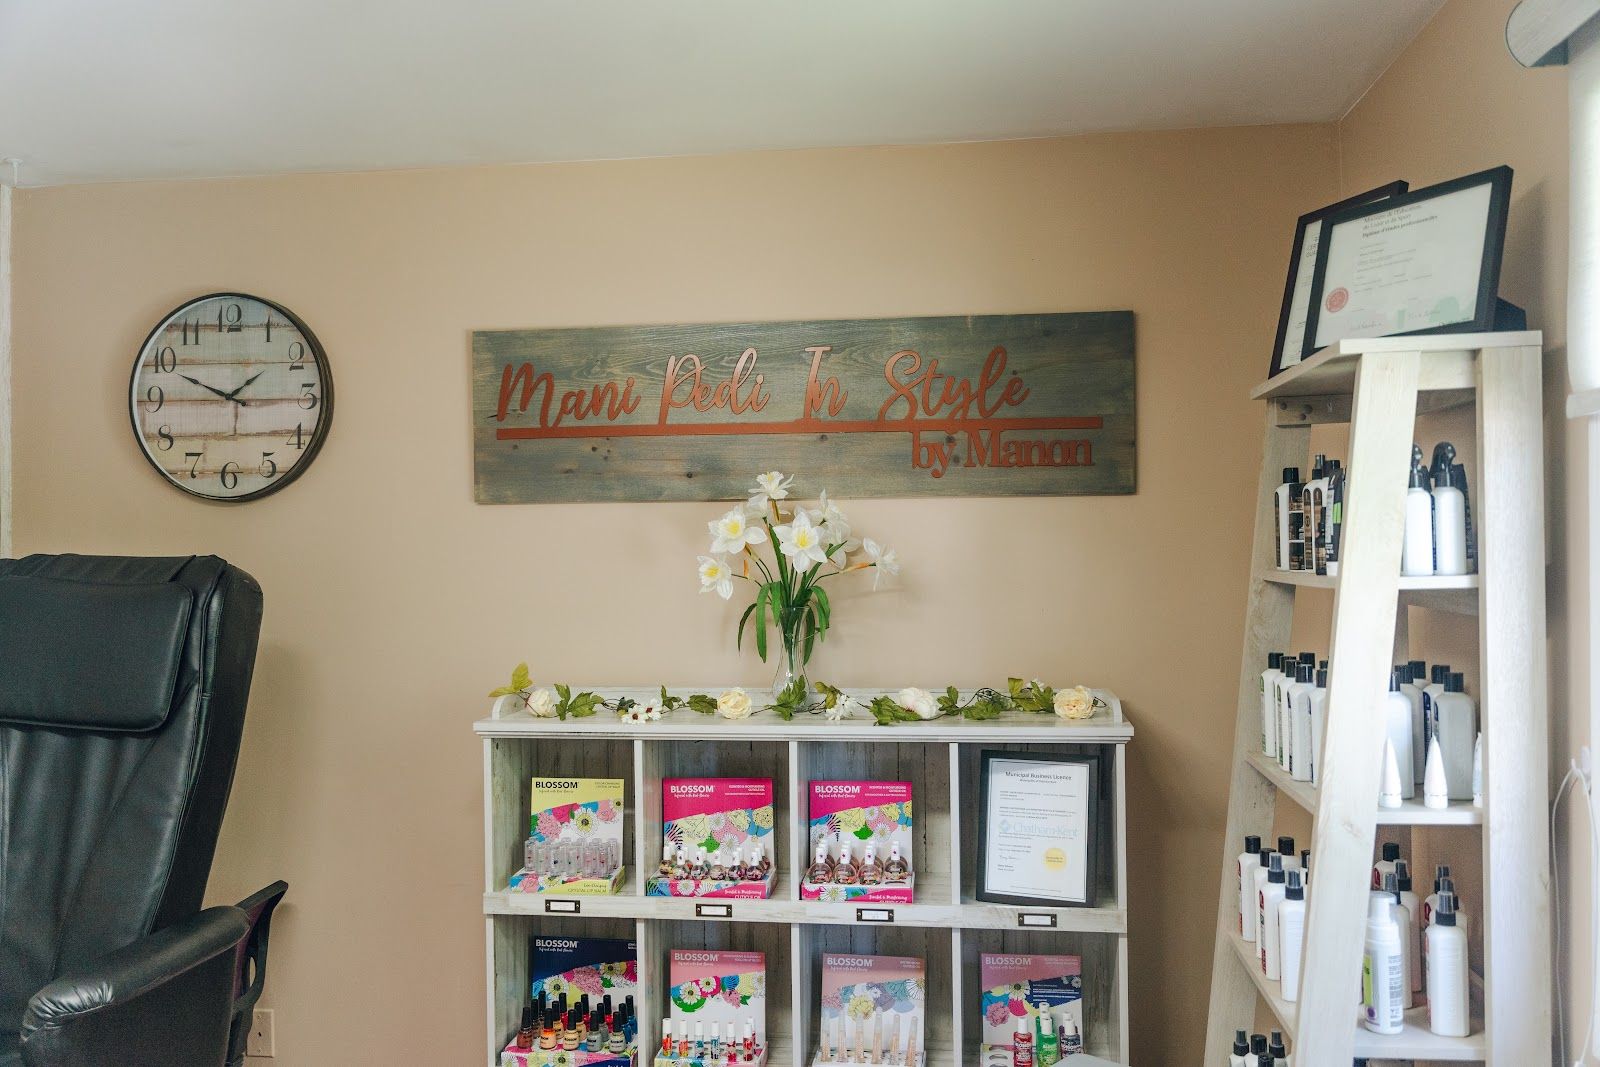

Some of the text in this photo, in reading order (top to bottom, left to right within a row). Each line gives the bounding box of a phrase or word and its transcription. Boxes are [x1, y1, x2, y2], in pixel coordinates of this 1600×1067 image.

[181, 317, 201, 346] 11
[216, 303, 242, 334] 12
[263, 314, 272, 343] 1
[153, 346, 177, 374] 10
[288, 341, 305, 372] 2
[144, 385, 164, 413] 9
[297, 382, 318, 410] 3
[496, 344, 1031, 434] Mani Pedi In Style
[157, 424, 174, 451] 8
[286, 421, 306, 450] 4
[184, 452, 204, 479] 7
[258, 451, 277, 479] 5
[911, 429, 1096, 479] by Manon
[220, 461, 240, 490] 6
[535, 781, 578, 789] BLOSSOM
[670, 785, 714, 793] BLOSSOM
[815, 785, 860, 794] BLOSSOM
[535, 939, 578, 948] BLOSSOM
[674, 952, 719, 962] BLOSSOM
[827, 957, 873, 967] BLOSSOM
[985, 957, 1032, 965] BLOSSOM
